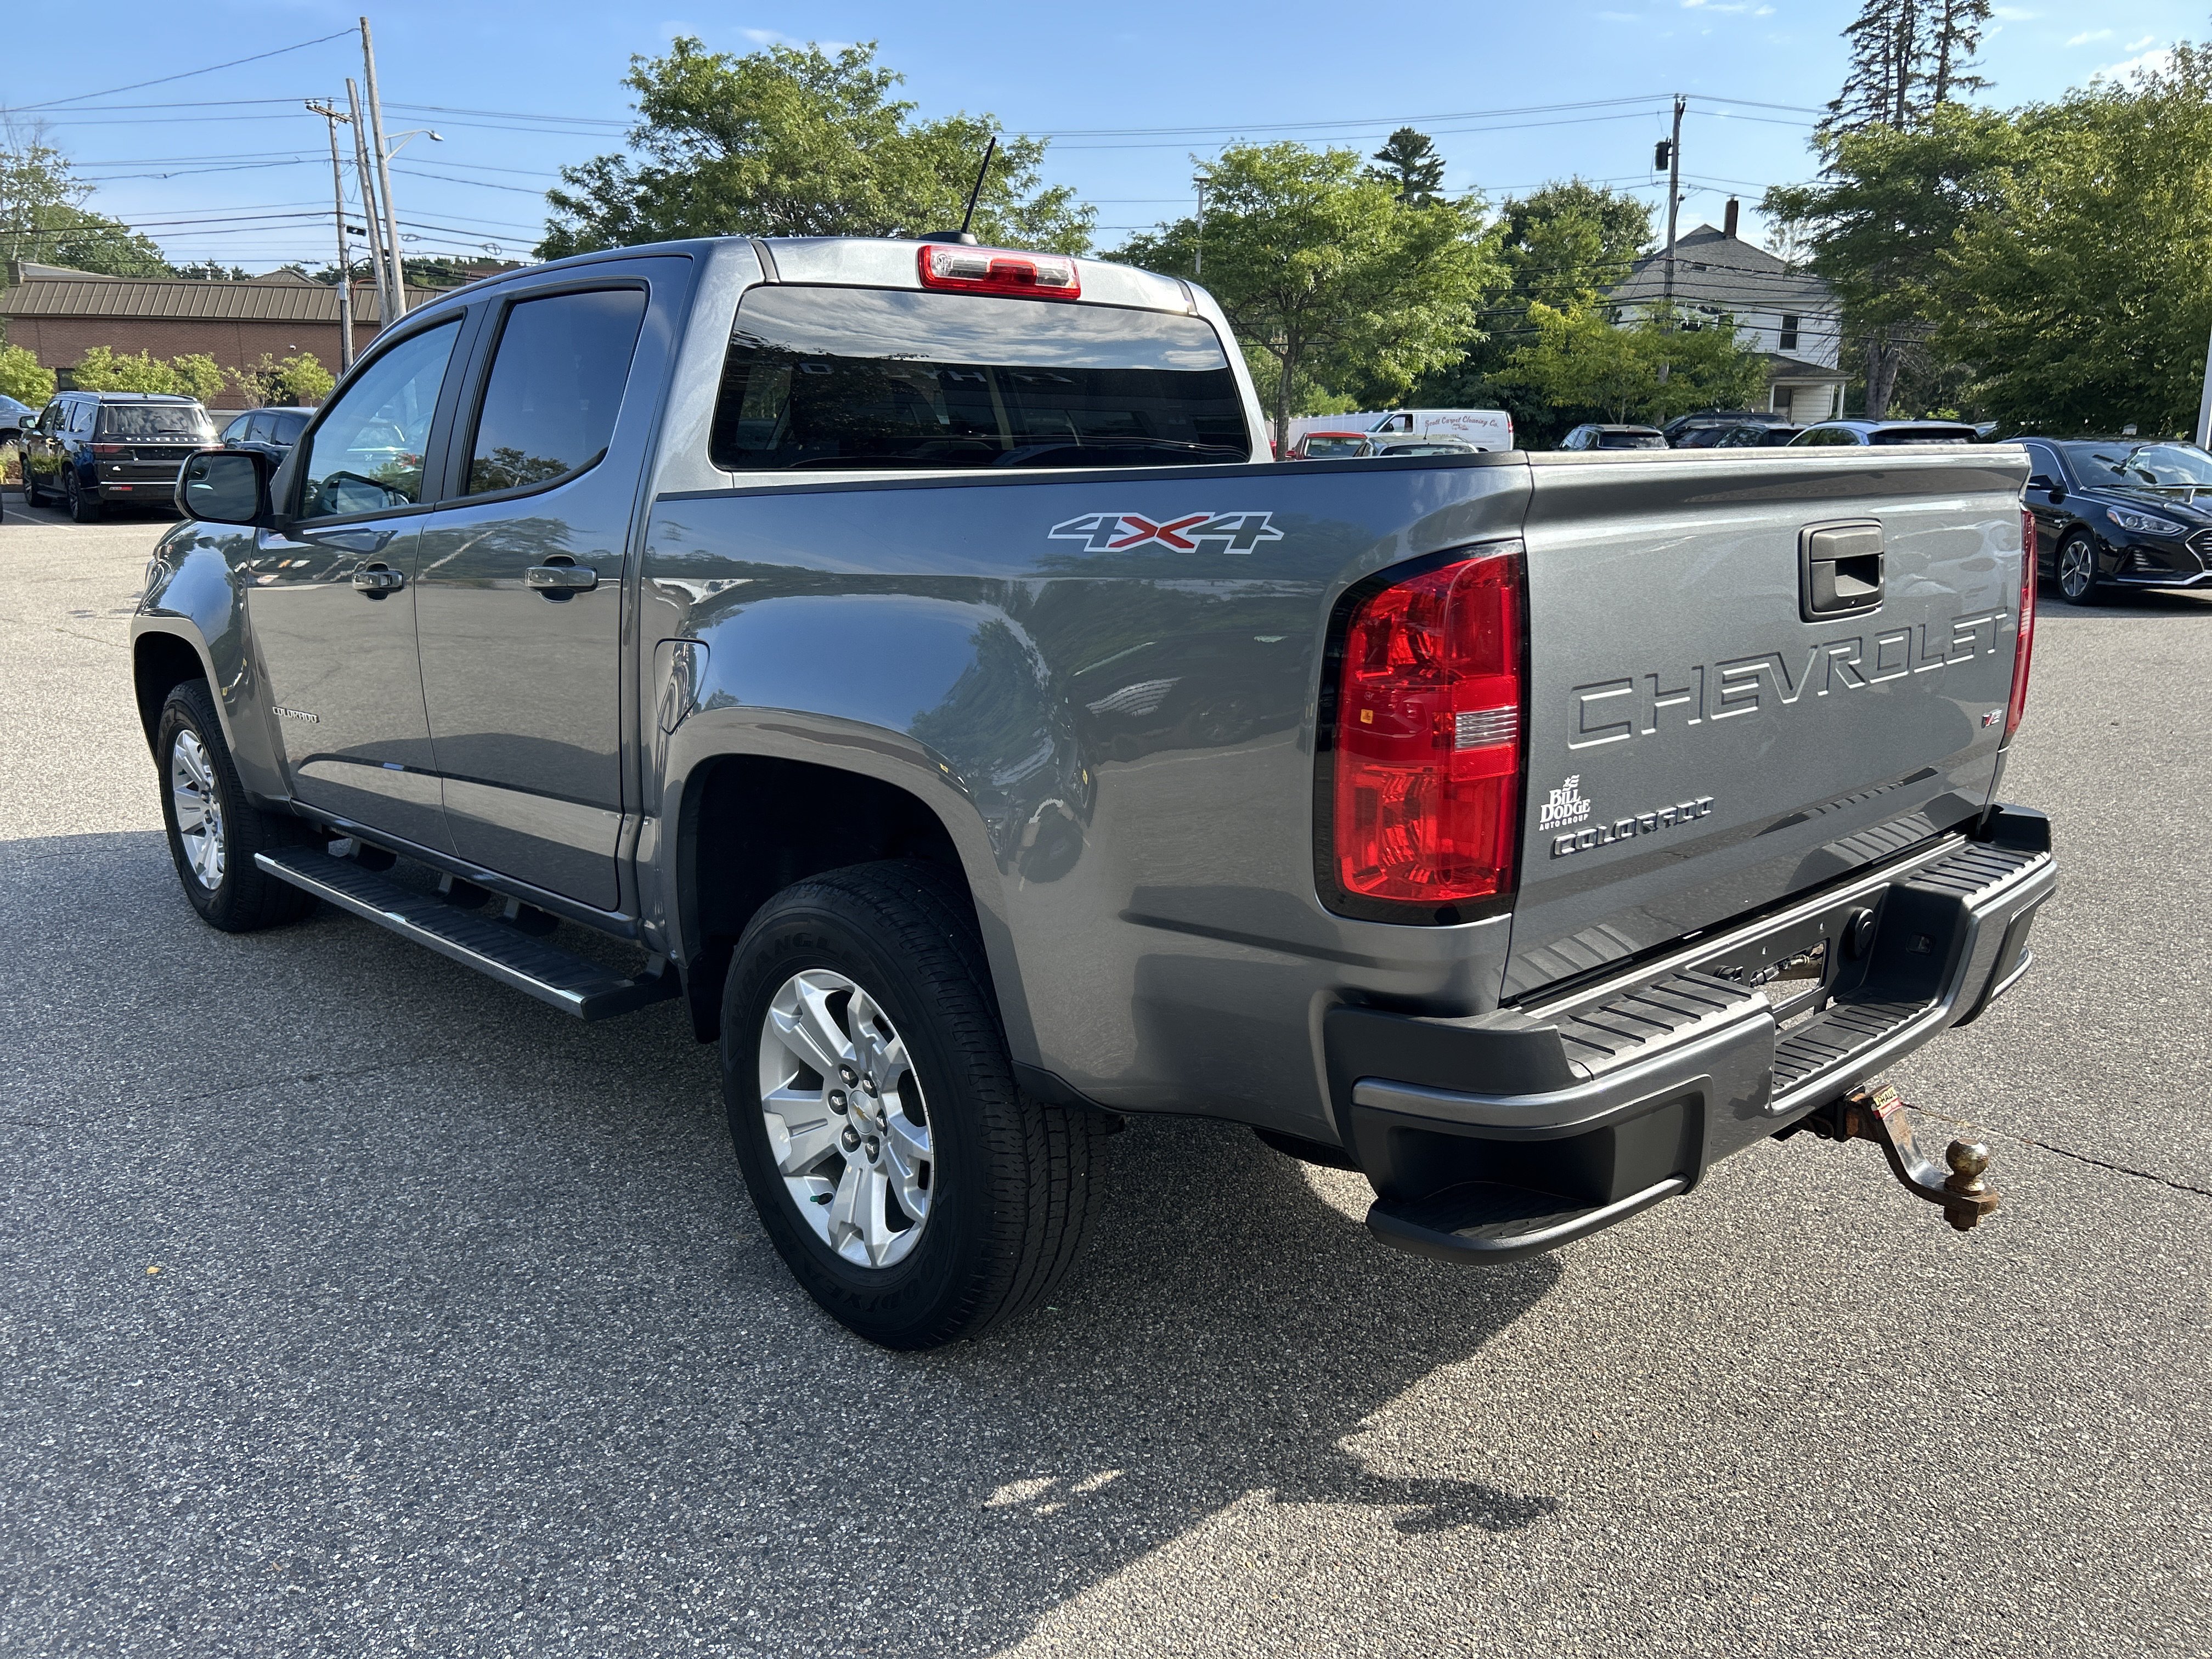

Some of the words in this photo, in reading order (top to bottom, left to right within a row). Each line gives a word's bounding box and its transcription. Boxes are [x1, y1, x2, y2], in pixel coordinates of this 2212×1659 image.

[1441, 416, 1462, 425] Carpet
[1462, 415, 1488, 427] Cleaning
[1568, 606, 2007, 750] CHEVROLET
[272, 706, 319, 723] COLORADO
[1549, 789, 1581, 807] BILL
[1540, 799, 1590, 823] DODGE
[1539, 820, 1560, 831] AUTO
[1562, 814, 1589, 825] GROUP
[1551, 796, 1714, 857] COLORADO
